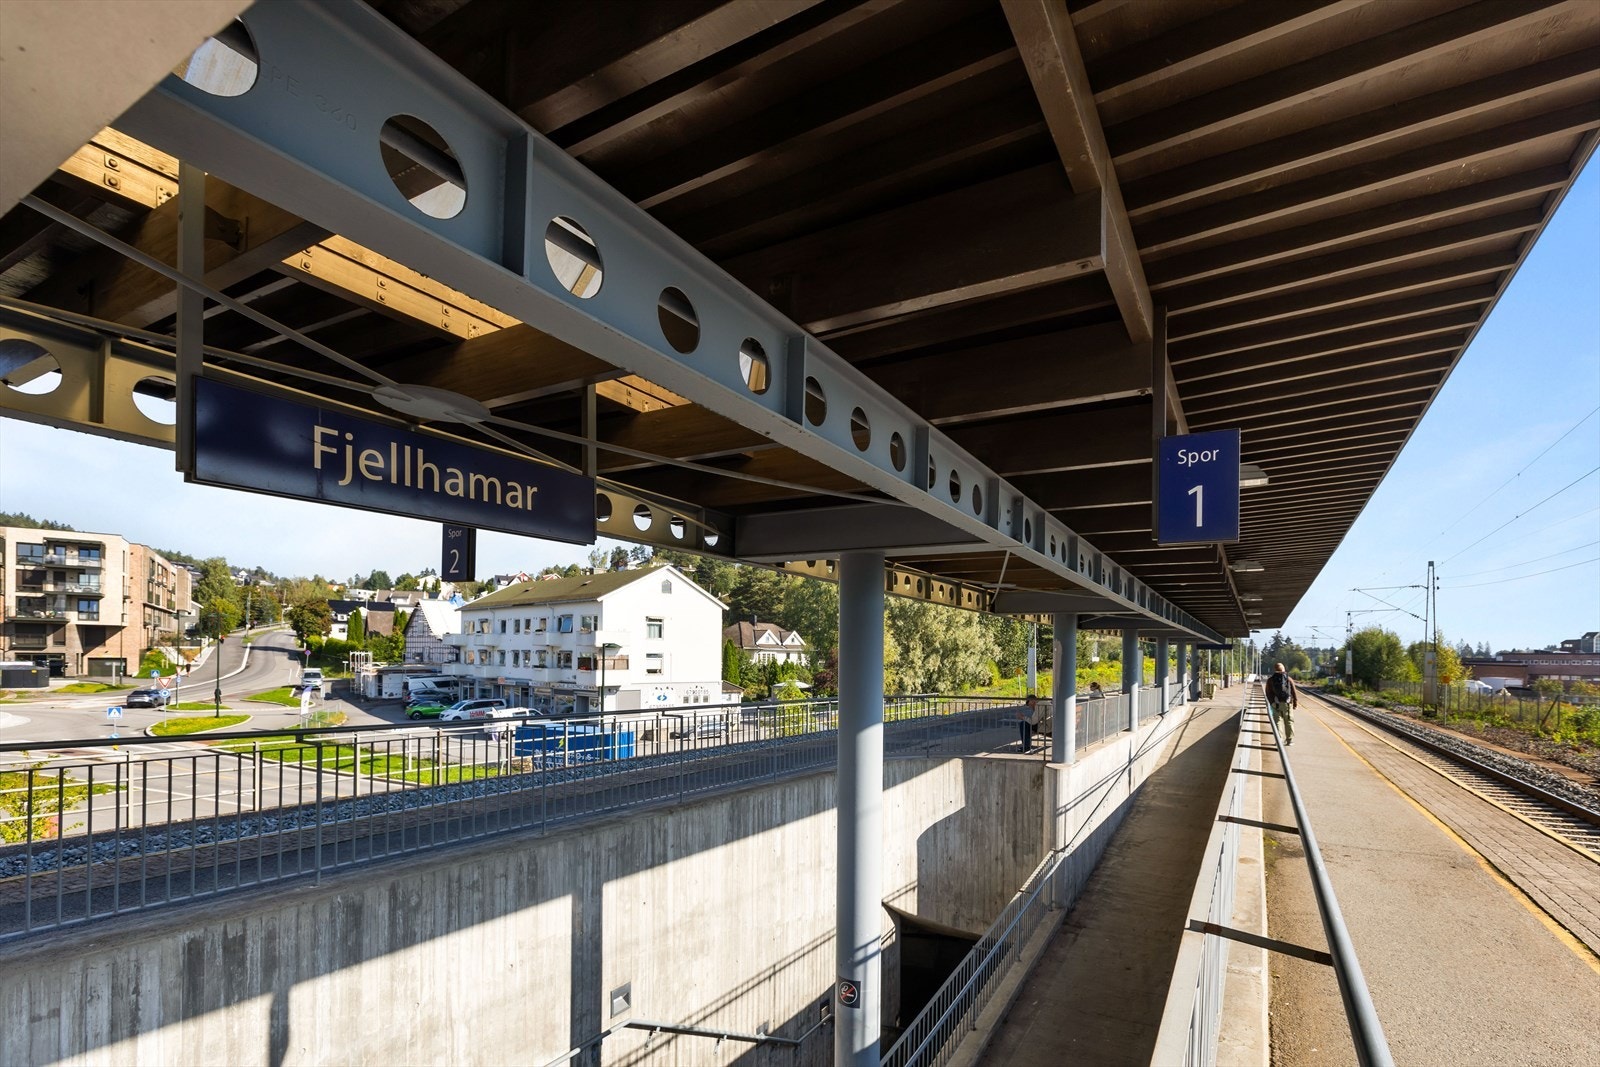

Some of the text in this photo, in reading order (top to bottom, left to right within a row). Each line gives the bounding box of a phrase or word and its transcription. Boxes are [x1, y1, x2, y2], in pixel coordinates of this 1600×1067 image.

[313, 425, 538, 511] Fjellhamar
[1177, 449, 1220, 467] Spor
[1188, 485, 1203, 527] 1
[448, 529, 462, 539] Spor
[449, 549, 459, 573] 2
